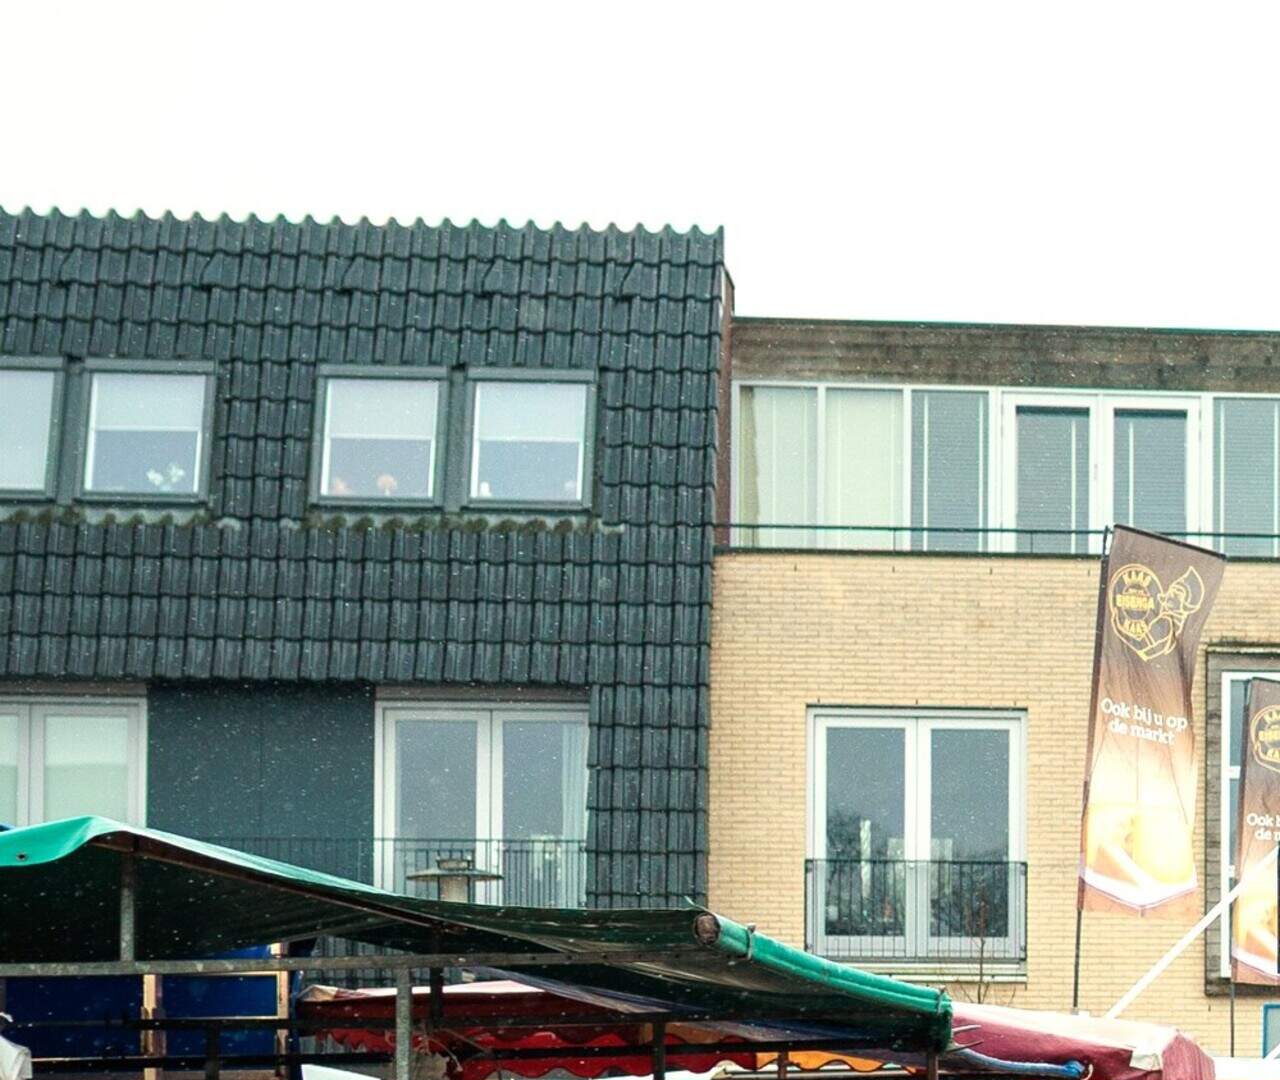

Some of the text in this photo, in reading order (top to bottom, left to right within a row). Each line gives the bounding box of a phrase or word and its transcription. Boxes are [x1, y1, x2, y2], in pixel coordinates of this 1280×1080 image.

[1101, 697, 1188, 732] Ook bij u op
[1109, 718, 1175, 746] de markt
[1246, 812, 1274, 826] Ook
[1254, 827, 1272, 841] de
